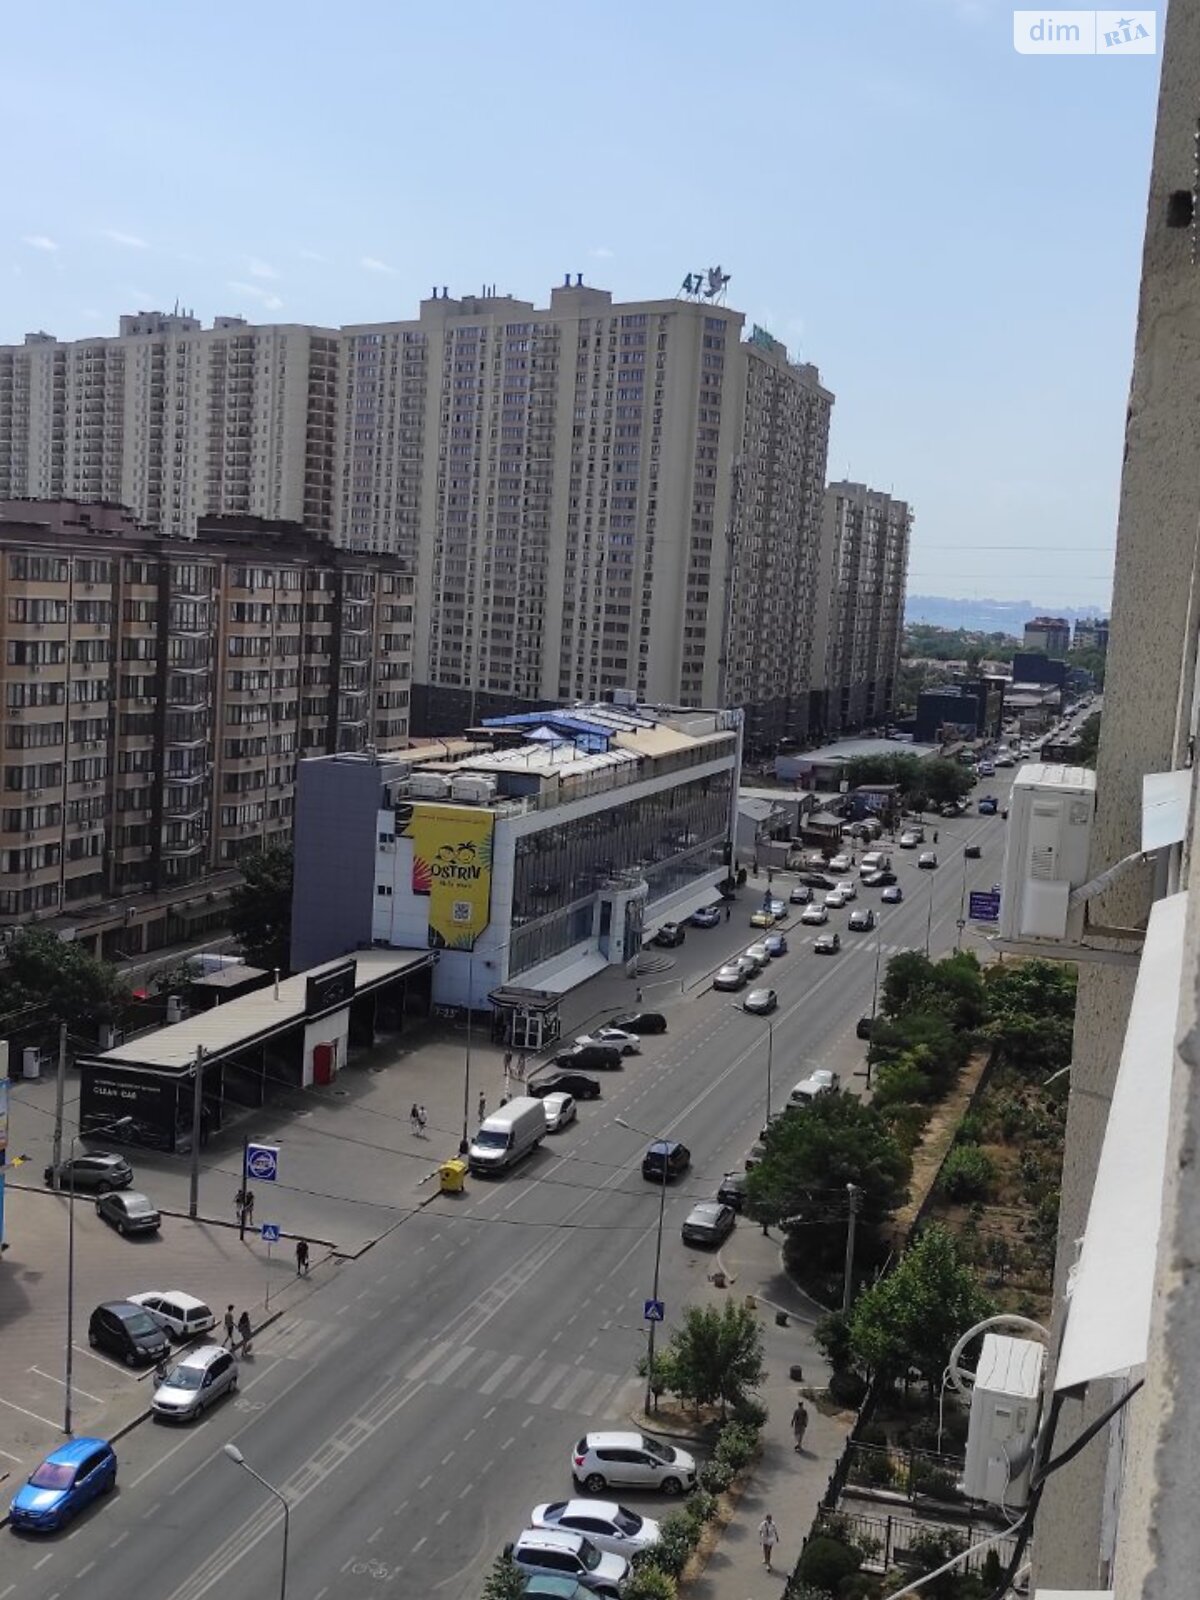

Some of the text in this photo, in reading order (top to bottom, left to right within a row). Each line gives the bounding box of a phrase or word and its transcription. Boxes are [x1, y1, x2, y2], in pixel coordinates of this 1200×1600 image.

[682, 272, 704, 295] 47
[431, 863, 481, 881] OSTRIV
[93, 1086, 118, 1096] CLEAN
